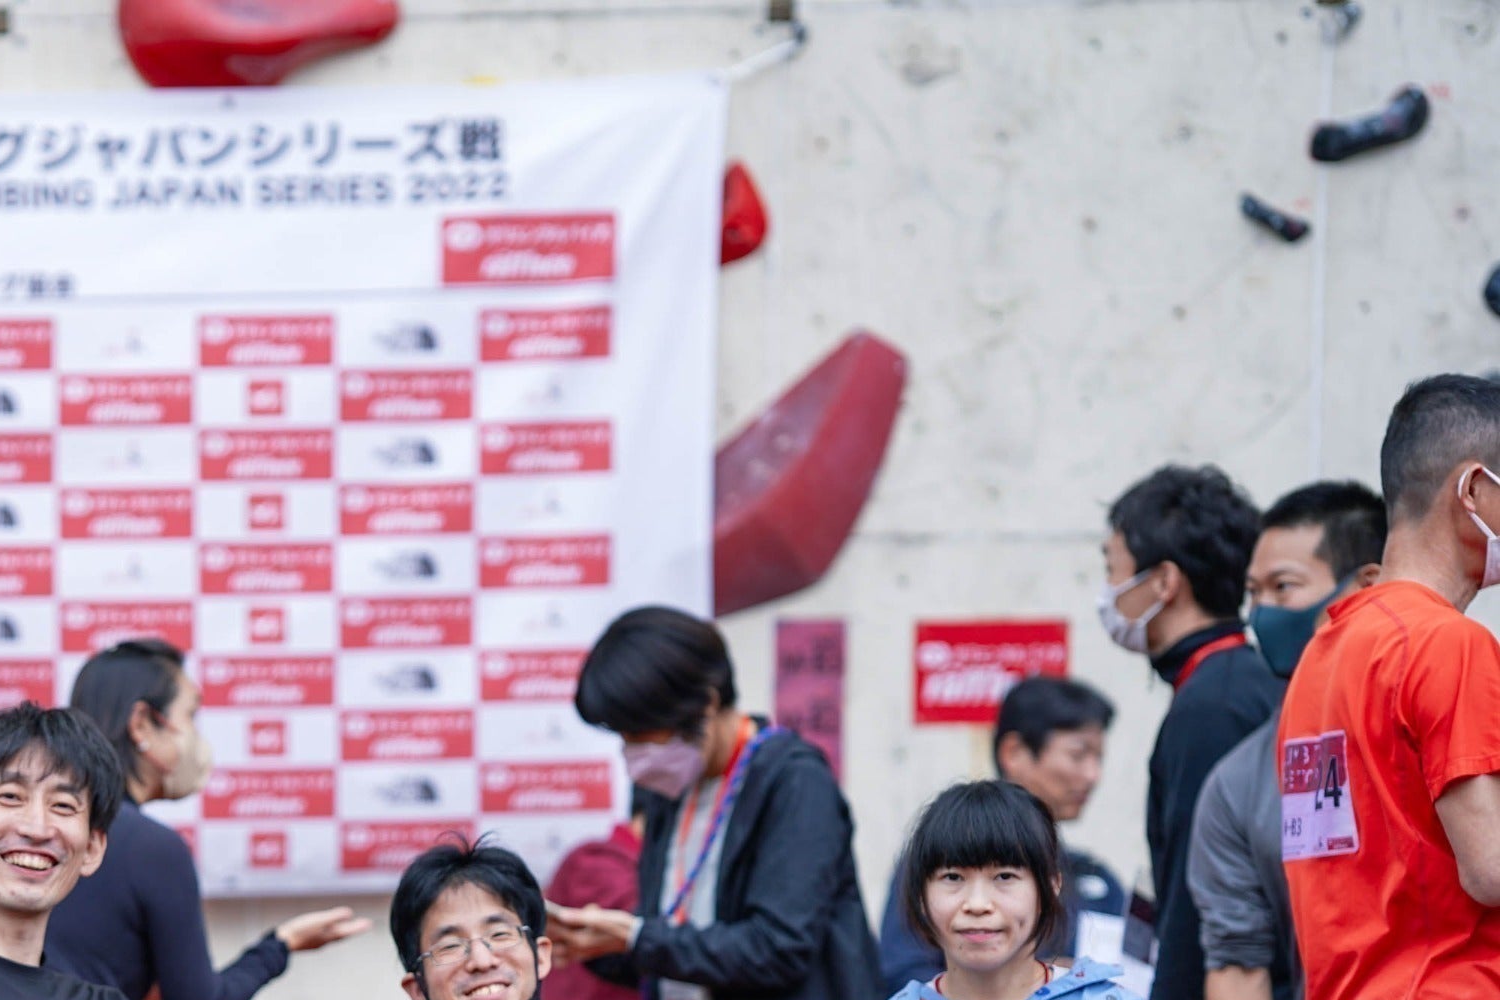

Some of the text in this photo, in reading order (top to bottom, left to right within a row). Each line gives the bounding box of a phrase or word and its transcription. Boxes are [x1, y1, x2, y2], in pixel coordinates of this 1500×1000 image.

[111, 176, 242, 208] JAPAN
[258, 174, 394, 205] SERIES
[408, 171, 508, 202] 2022
